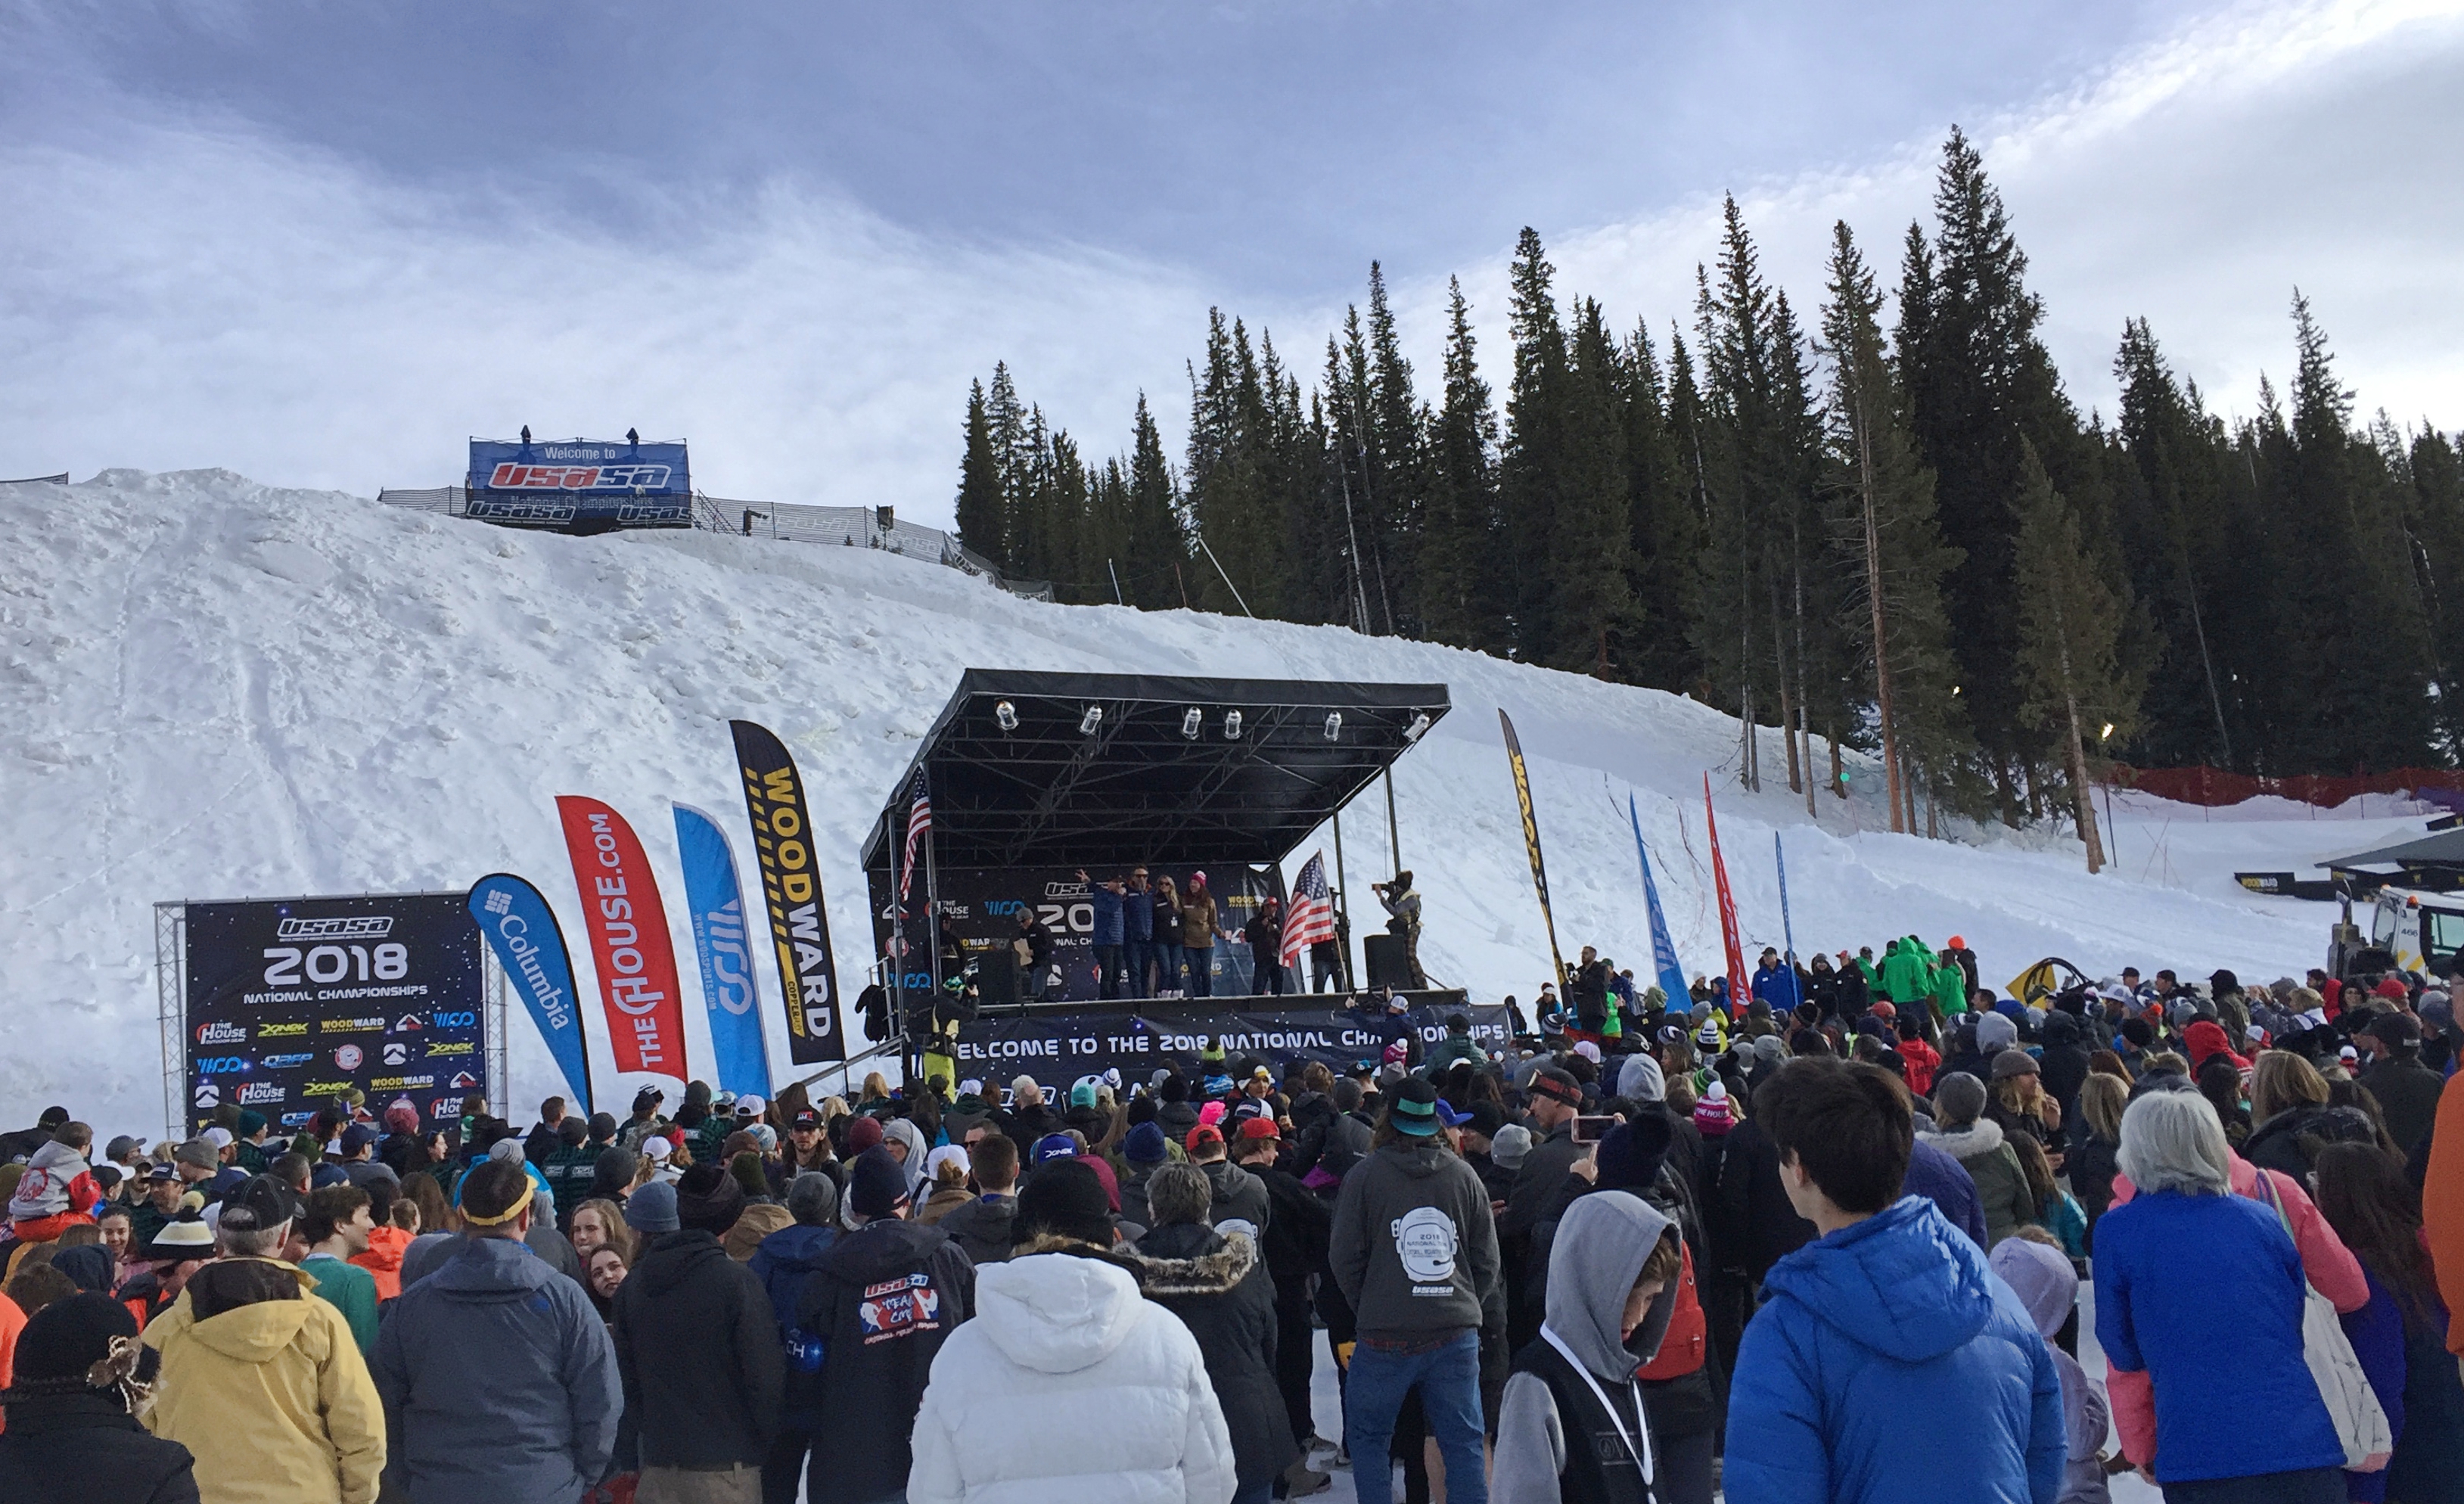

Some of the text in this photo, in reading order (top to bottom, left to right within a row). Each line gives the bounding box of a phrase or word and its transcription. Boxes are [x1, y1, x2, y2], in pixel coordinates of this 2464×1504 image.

[544, 446, 616, 459] Welcome to
[764, 766, 831, 1038] WOODWARD
[588, 813, 664, 1068] THE HOUSE.COM
[264, 943, 408, 986] 2018
[499, 914, 569, 1031] Columbia
[244, 985, 428, 1004] NATIONAL CHAMPIONSHIPS
[321, 1017, 386, 1028] WOODWARD
[200, 1023, 247, 1045] HOUSE
[1069, 1037, 1098, 1055] TO
[1108, 1035, 1150, 1053] THE
[1159, 1034, 1209, 1052] 2018
[1219, 1030, 1332, 1051] NATIONAL
[371, 1075, 434, 1087] WOODWARD
[240, 1083, 286, 1105] HOUSE
